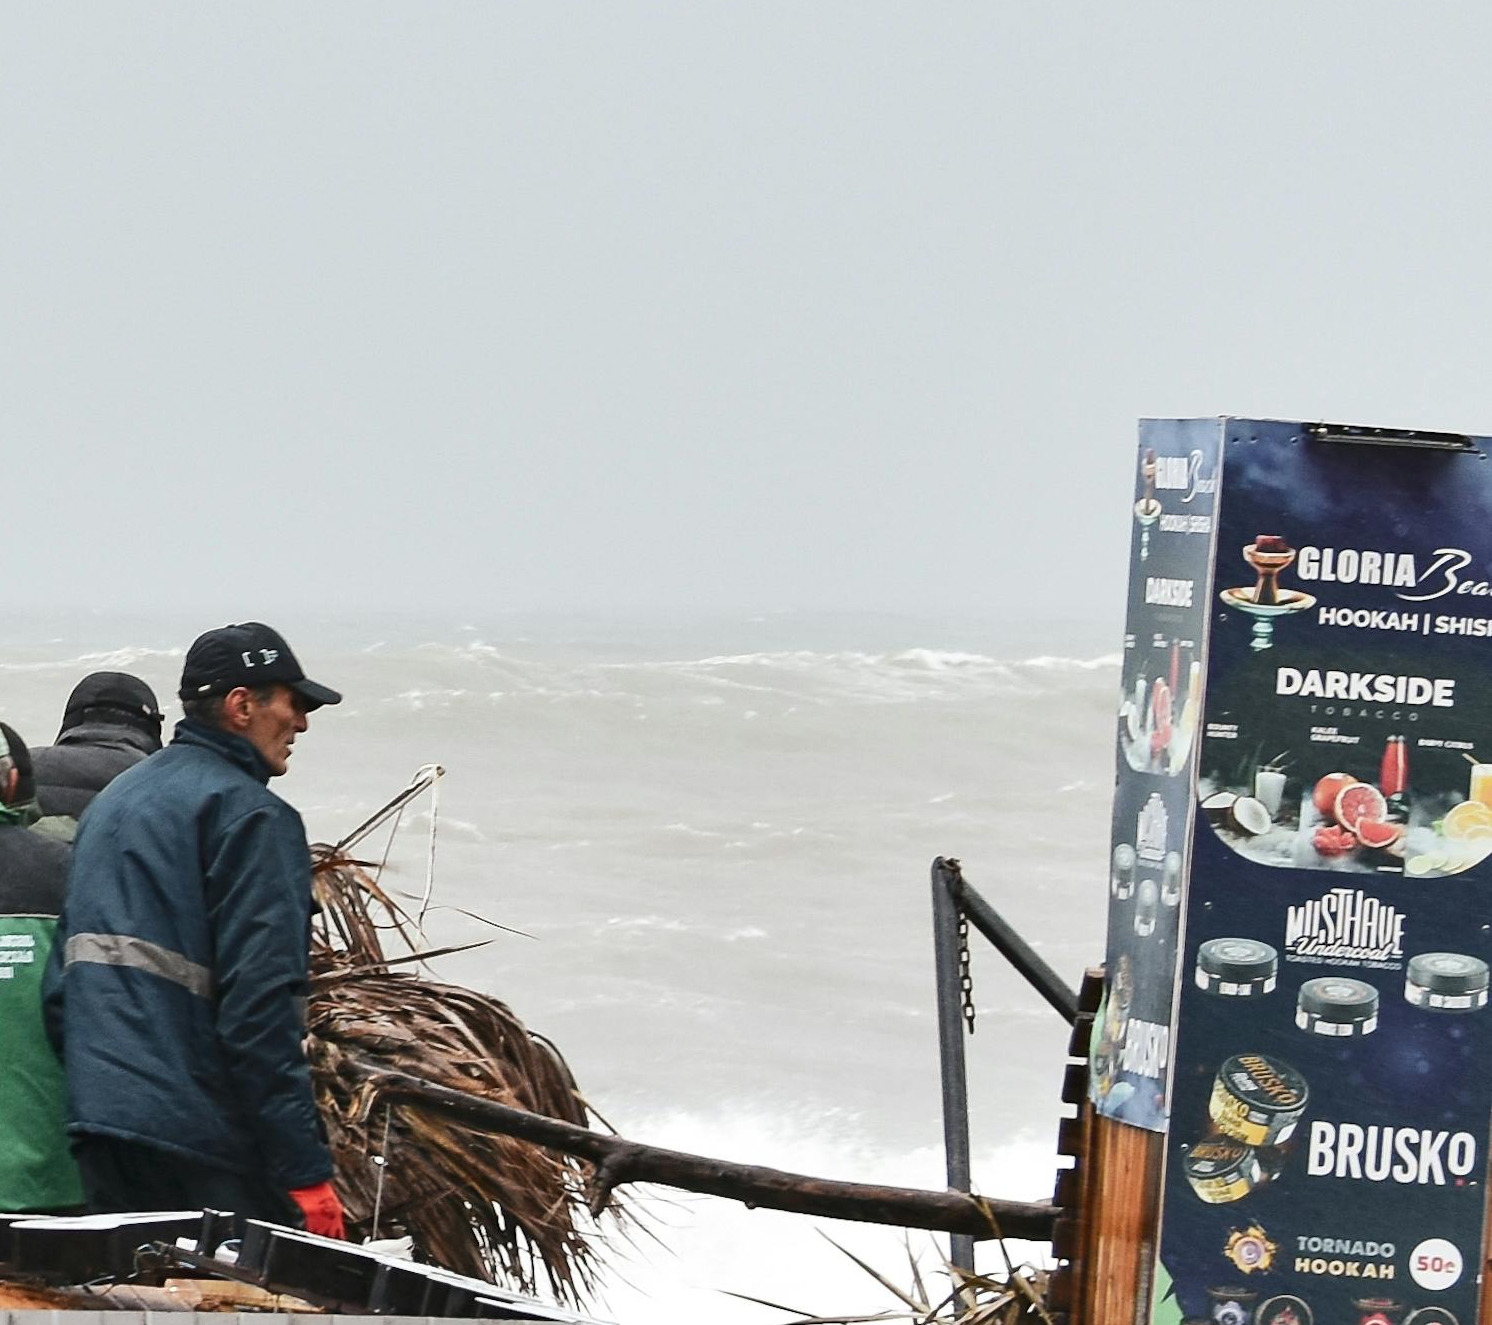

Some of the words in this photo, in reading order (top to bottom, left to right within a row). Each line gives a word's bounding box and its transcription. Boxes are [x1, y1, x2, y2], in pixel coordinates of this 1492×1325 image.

[1296, 545, 1417, 588] GLORIA
[1318, 606, 1419, 633] HOOKAH
[1275, 667, 1455, 708] DARKSIDE
[1310, 704, 1420, 722] TOBACCO
[1296, 936, 1393, 960] Undercoal
[1237, 1055, 1301, 1104] BRUSKO
[1307, 1120, 1477, 1187] BRUSKO
[1296, 1236, 1396, 1258] TORNADO
[1294, 1257, 1396, 1280] HOOKAH
